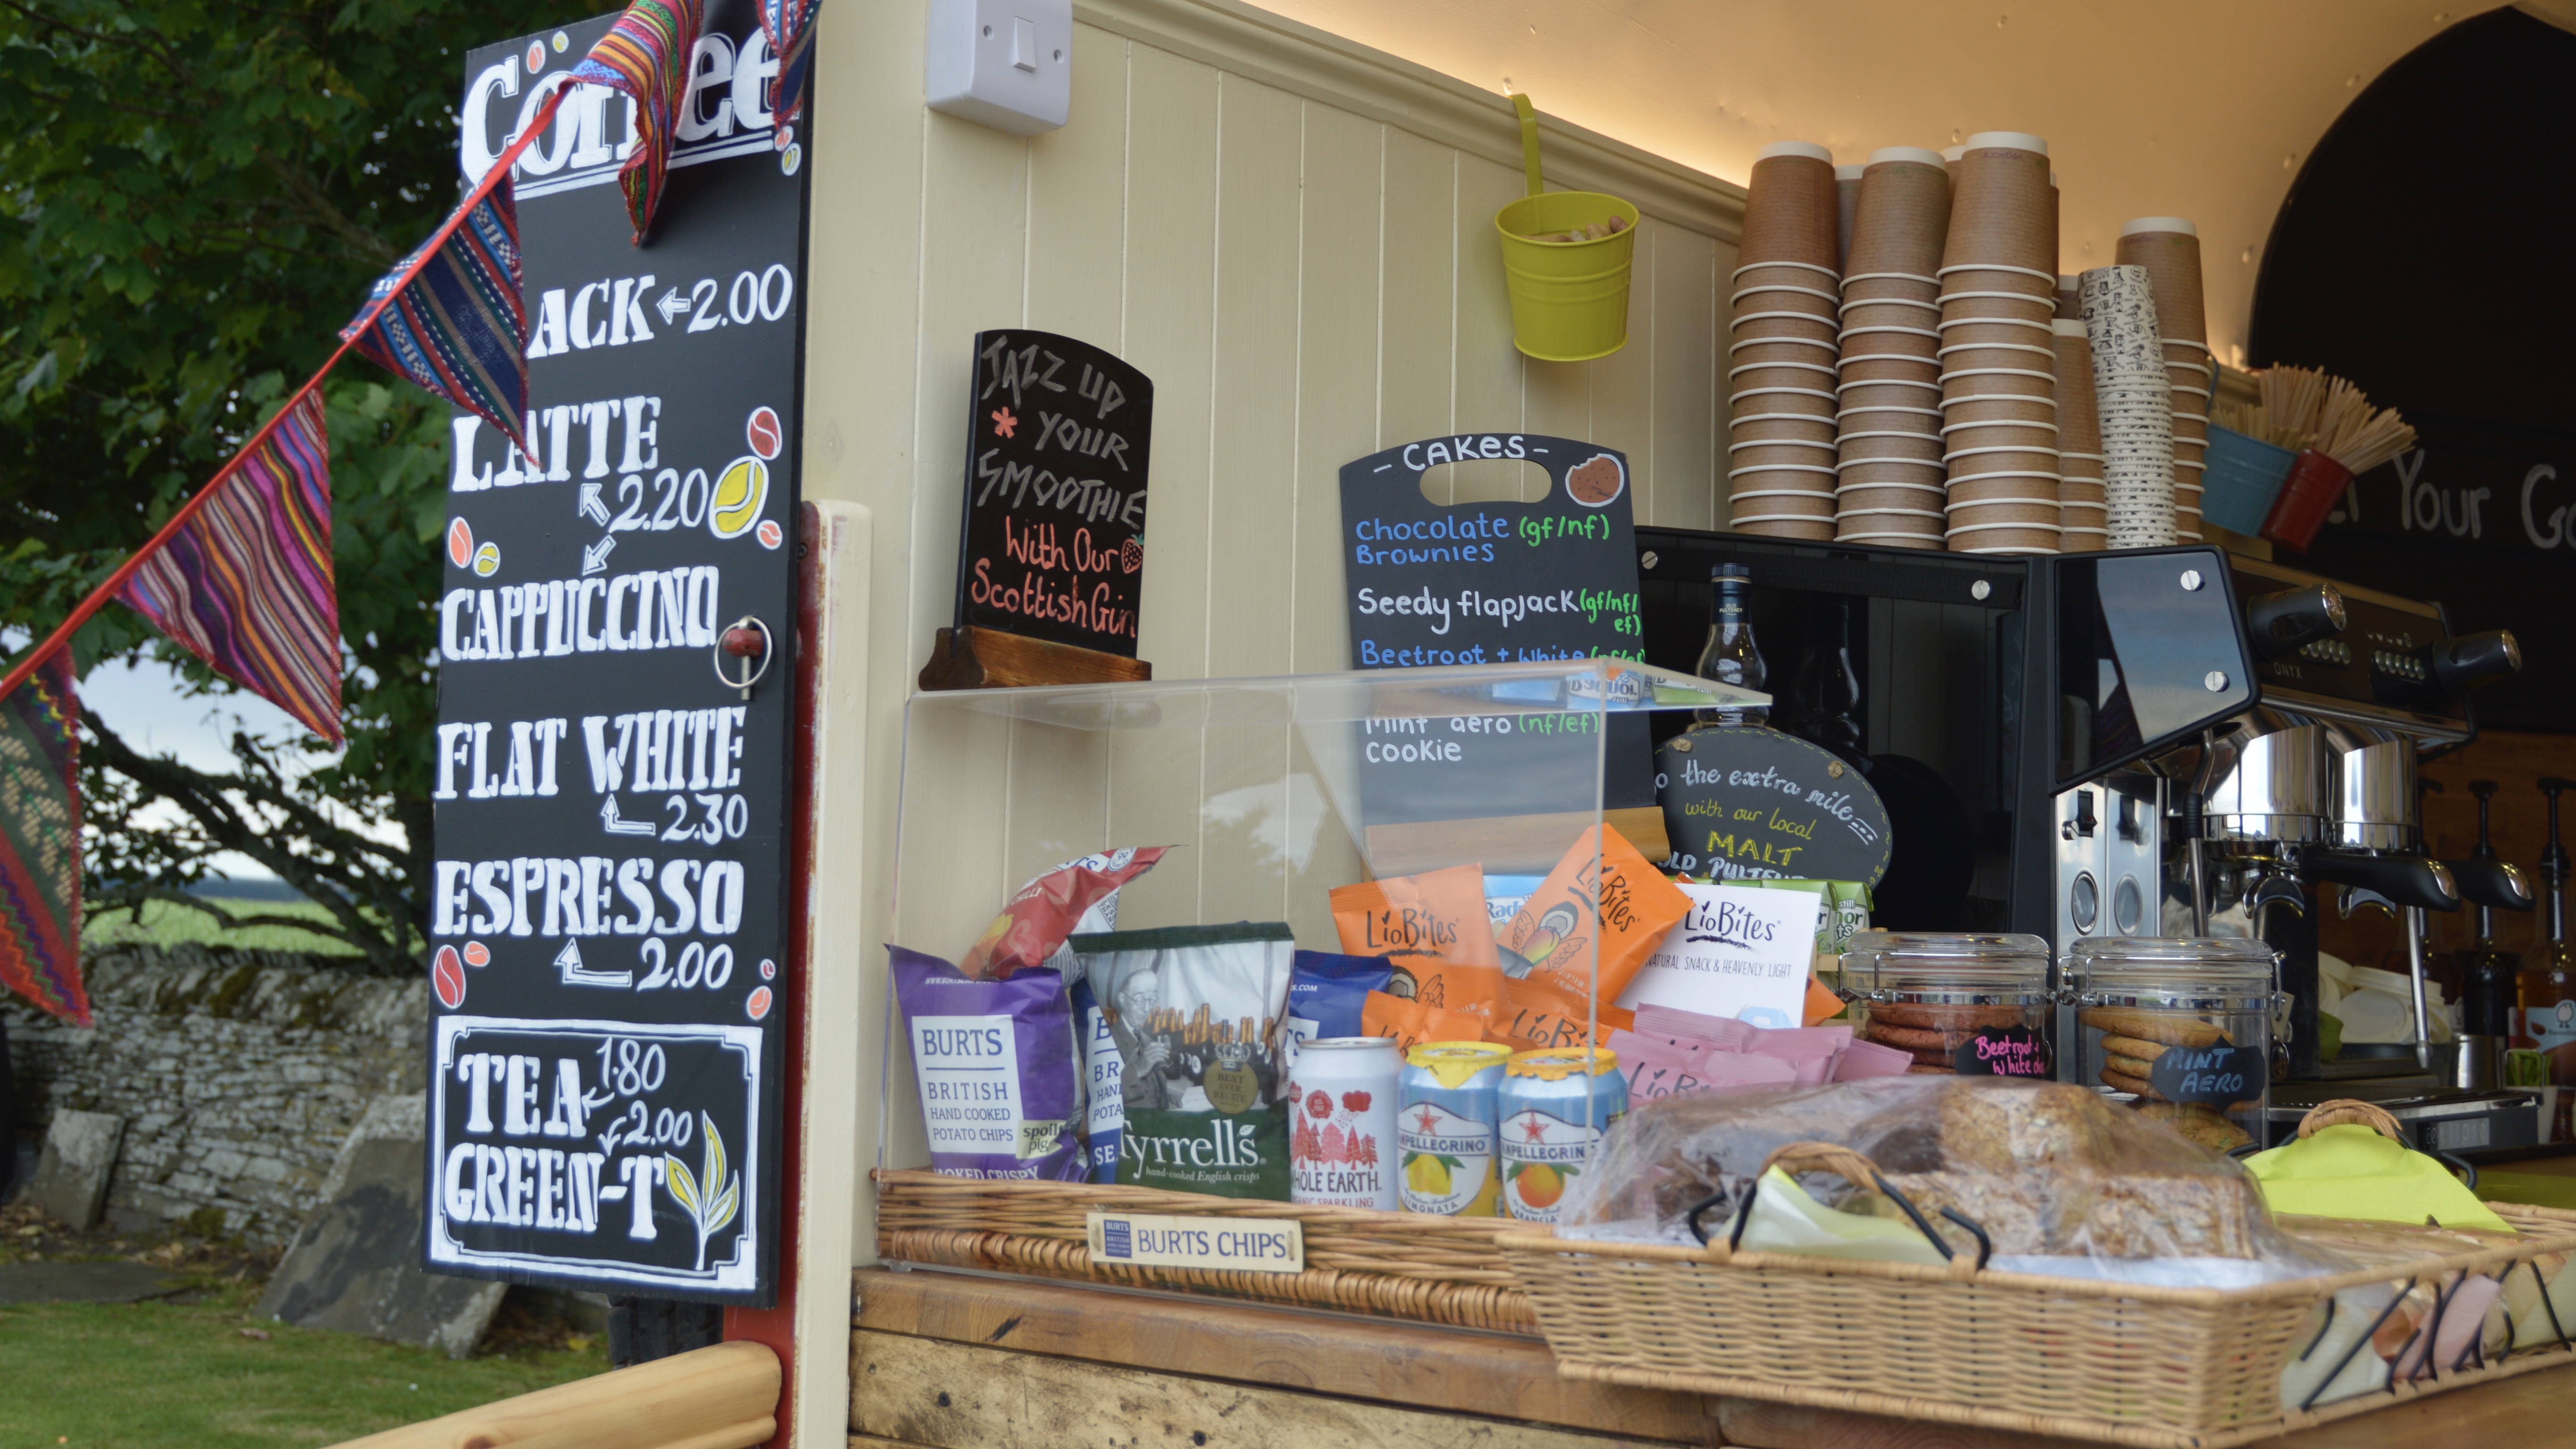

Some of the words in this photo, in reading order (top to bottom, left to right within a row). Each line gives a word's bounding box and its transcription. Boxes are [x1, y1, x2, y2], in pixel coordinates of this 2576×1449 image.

[528, 275, 655, 359] ACK
[687, 264, 793, 334] 2.00
[981, 334, 1067, 411] JAZZ
[1078, 364, 1126, 420] UP
[452, 396, 661, 491] LATTE
[1035, 410, 1129, 472] YOUR
[608, 467, 709, 533] 2.20
[977, 447, 1148, 530] SMOOTHIE
[2393, 448, 2491, 539] Your
[1005, 515, 1069, 571] With
[1073, 527, 1118, 573] Our
[1519, 514, 1610, 547] (gf/nf)
[1356, 542, 1495, 565] Brownies
[971, 556, 1087, 628] Scottish
[1091, 581, 1136, 638] Gin
[1358, 586, 1450, 635] Seedy
[442, 565, 720, 661] CAPPUCCINO
[1614, 615, 1641, 637] ef)
[1361, 639, 1486, 667] Beetroot
[1497, 647, 1509, 662] +
[2273, 661, 2303, 679] ONYX
[1450, 713, 1512, 734] aero
[1518, 712, 1599, 736] (nf/ef)
[432, 718, 567, 799] FLAT
[582, 706, 746, 793] WHITE
[1680, 759, 1721, 787] the
[1729, 765, 1801, 795] extra
[1805, 791, 1853, 821] mile
[661, 793, 748, 845] 2.30
[1685, 798, 1723, 818] with
[1733, 807, 1763, 821] our
[1769, 807, 1817, 841] local
[1706, 830, 1803, 867] MALT
[433, 856, 744, 936] ESPRESSO
[1839, 899, 1855, 909] still
[1366, 907, 1458, 949] LioBites
[1685, 897, 1776, 941] LioBites
[637, 936, 734, 992] 2.00
[1646, 952, 1680, 969] NATURAL
[1684, 955, 1710, 972] SNACK
[1713, 959, 1720, 972] &
[1722, 958, 1764, 977] HEAVENLY
[1768, 962, 1792, 978] LIGHT
[922, 1028, 1003, 1056] BURTS
[1974, 1034, 2033, 1060] Beetroot
[596, 1037, 666, 1095] 1.80
[2165, 1048, 2236, 1070] MINT
[928, 1082, 1009, 1100] BRITISH
[1218, 1073, 1245, 1084] BEST
[2179, 1071, 2243, 1093] AERO
[458, 1052, 587, 1137] TEA
[1213, 1090, 1247, 1102] RECIPE
[623, 1099, 693, 1146] 2.00
[930, 1108, 962, 1121] HAND
[964, 1108, 1011, 1121] COOKED
[1093, 1103, 1124, 1122] POTA
[933, 1127, 975, 1141] POTATO
[979, 1128, 1014, 1142] CHIPS
[1028, 1138, 1049, 1154] pig
[1093, 1143, 1118, 1166] SE
[987, 1166, 1039, 1180] CRISPY
[1145, 1166, 1195, 1181] hand-cooked
[1197, 1170, 1231, 1184] English
[1234, 1172, 1260, 1184] crisps
[444, 1142, 665, 1240] GREEN-T
[1317, 1197, 1374, 1208] SPARKLING
[1404, 1195, 1458, 1213] LIMONATA
[1105, 1221, 1129, 1232] BURTS
[1138, 1229, 1209, 1258] BURTS
[1217, 1232, 1286, 1259] CHIPS
